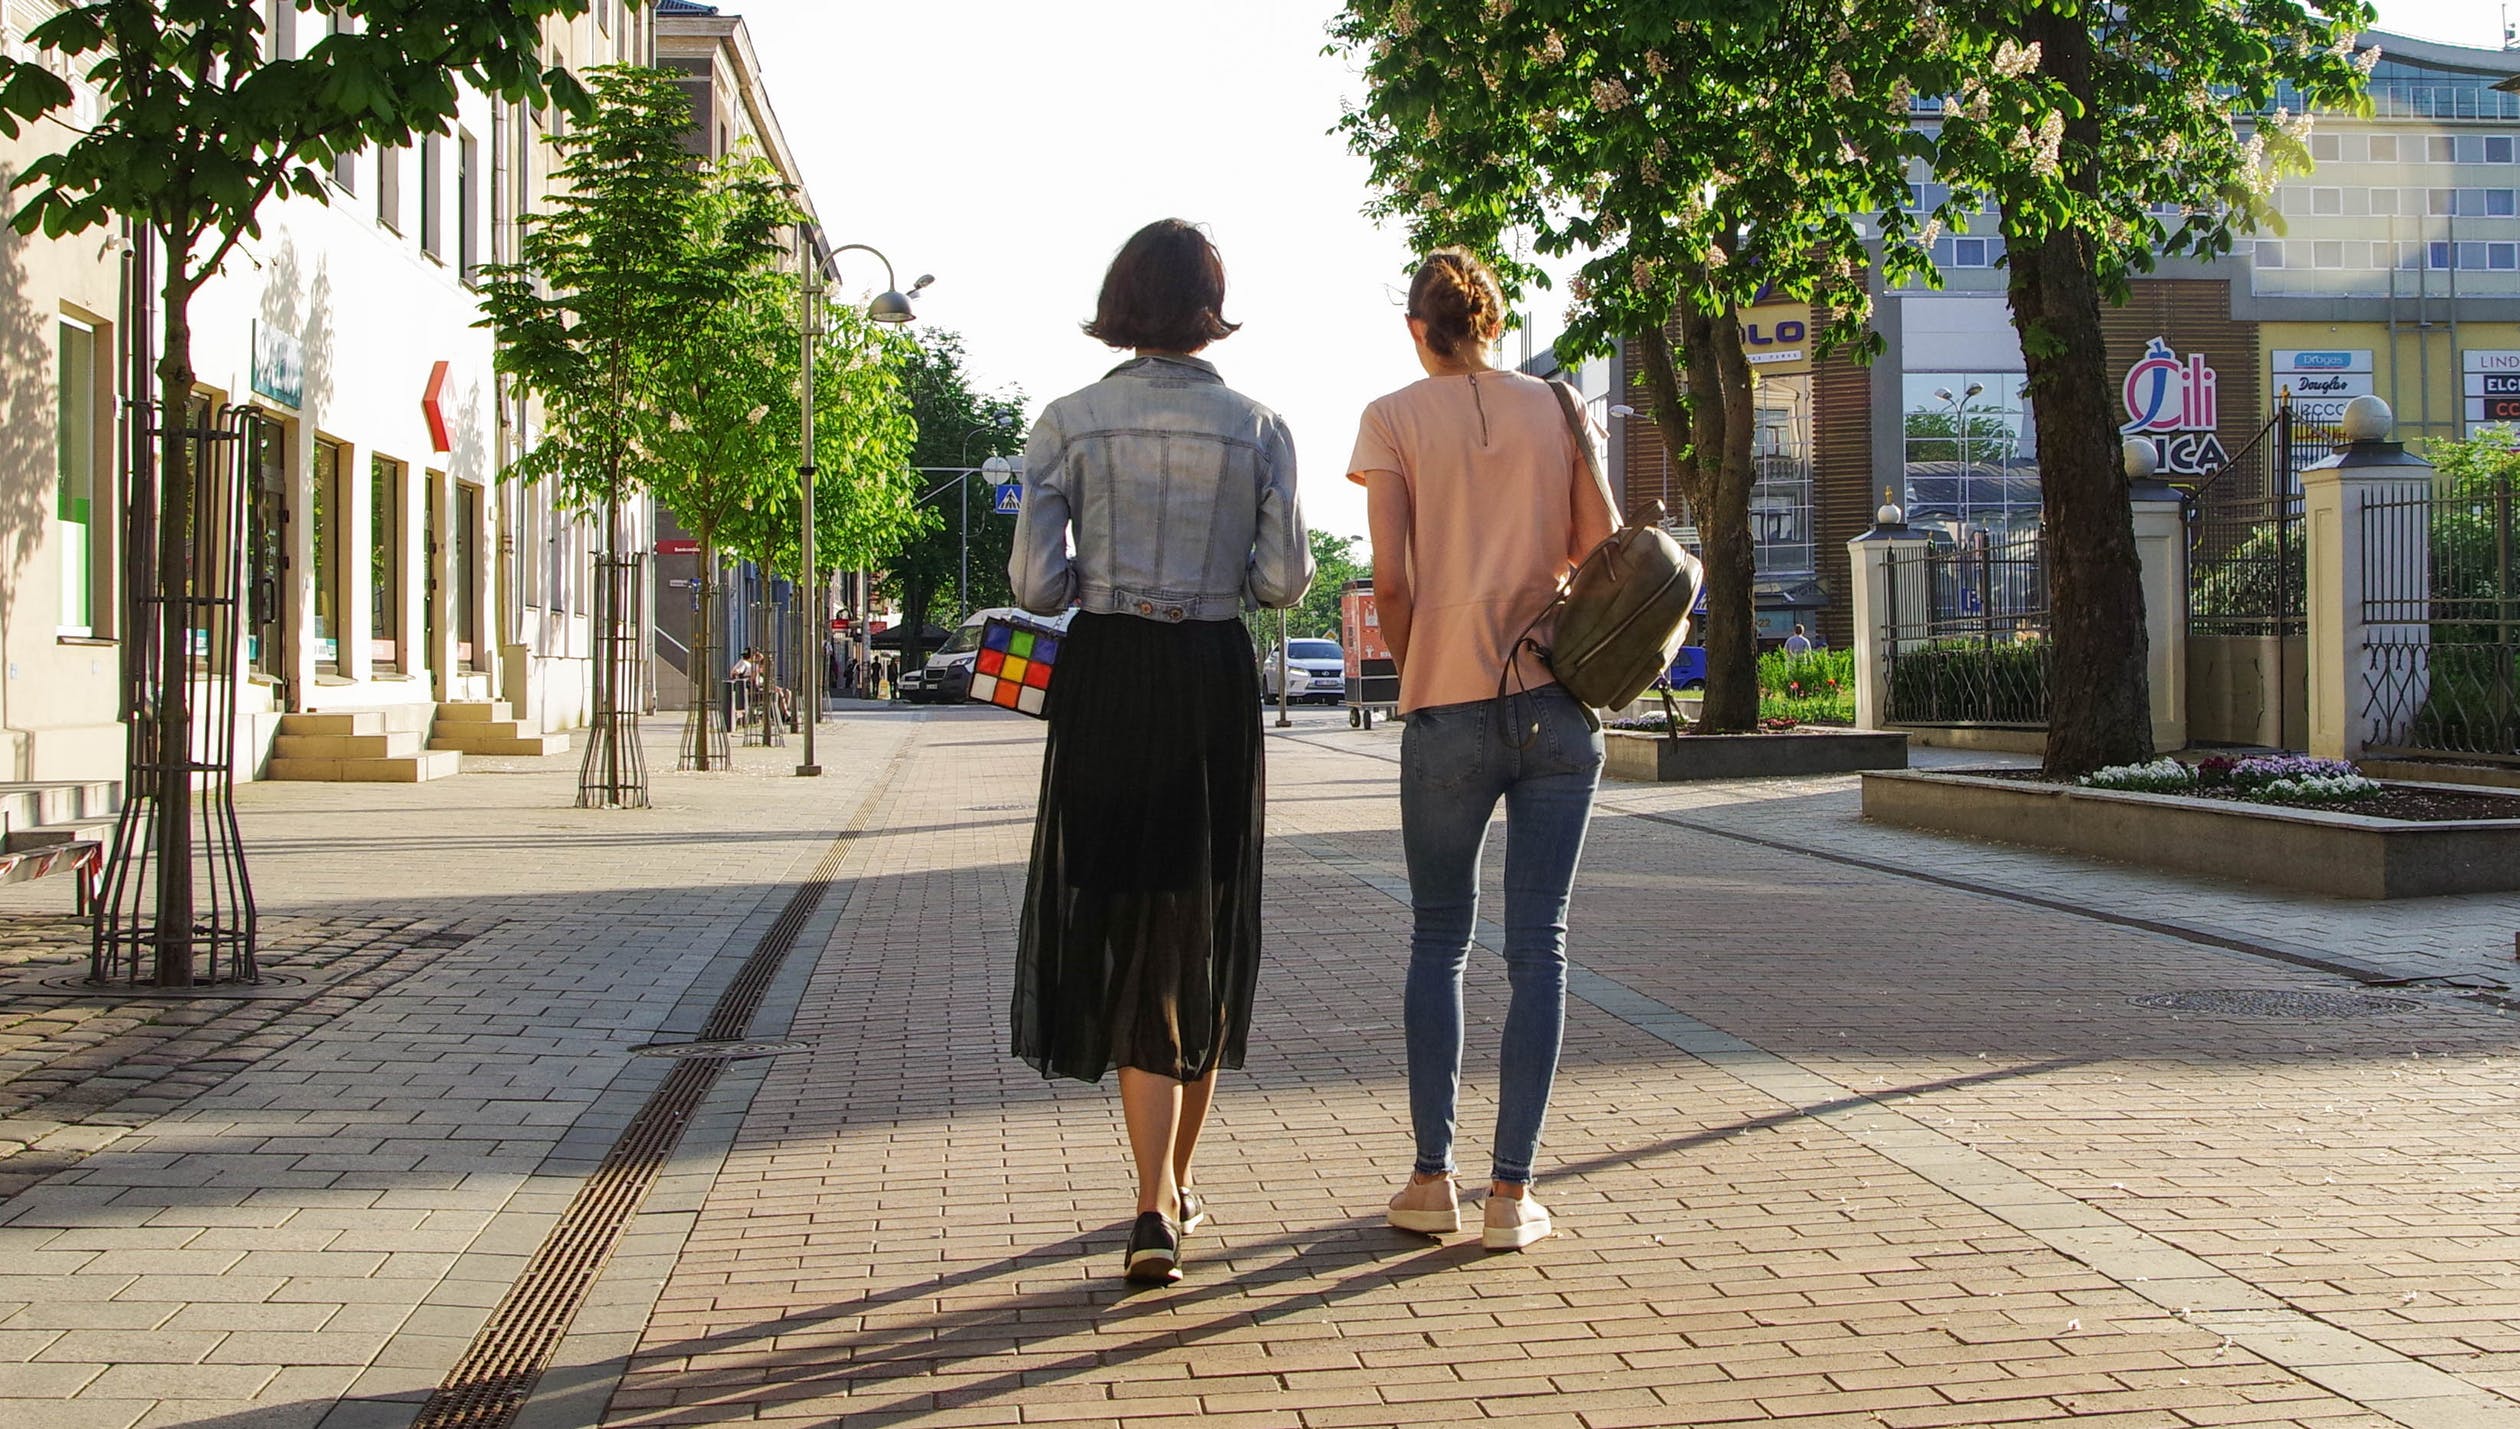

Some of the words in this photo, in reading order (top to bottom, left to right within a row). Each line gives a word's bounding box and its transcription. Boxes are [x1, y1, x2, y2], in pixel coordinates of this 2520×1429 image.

[1739, 321, 1804, 345] LO
[2303, 354, 2344, 365] Drogas
[2298, 376, 2348, 394] Douglas
[2487, 379, 2520, 391] ELC
[2125, 435, 2234, 475] ICA
